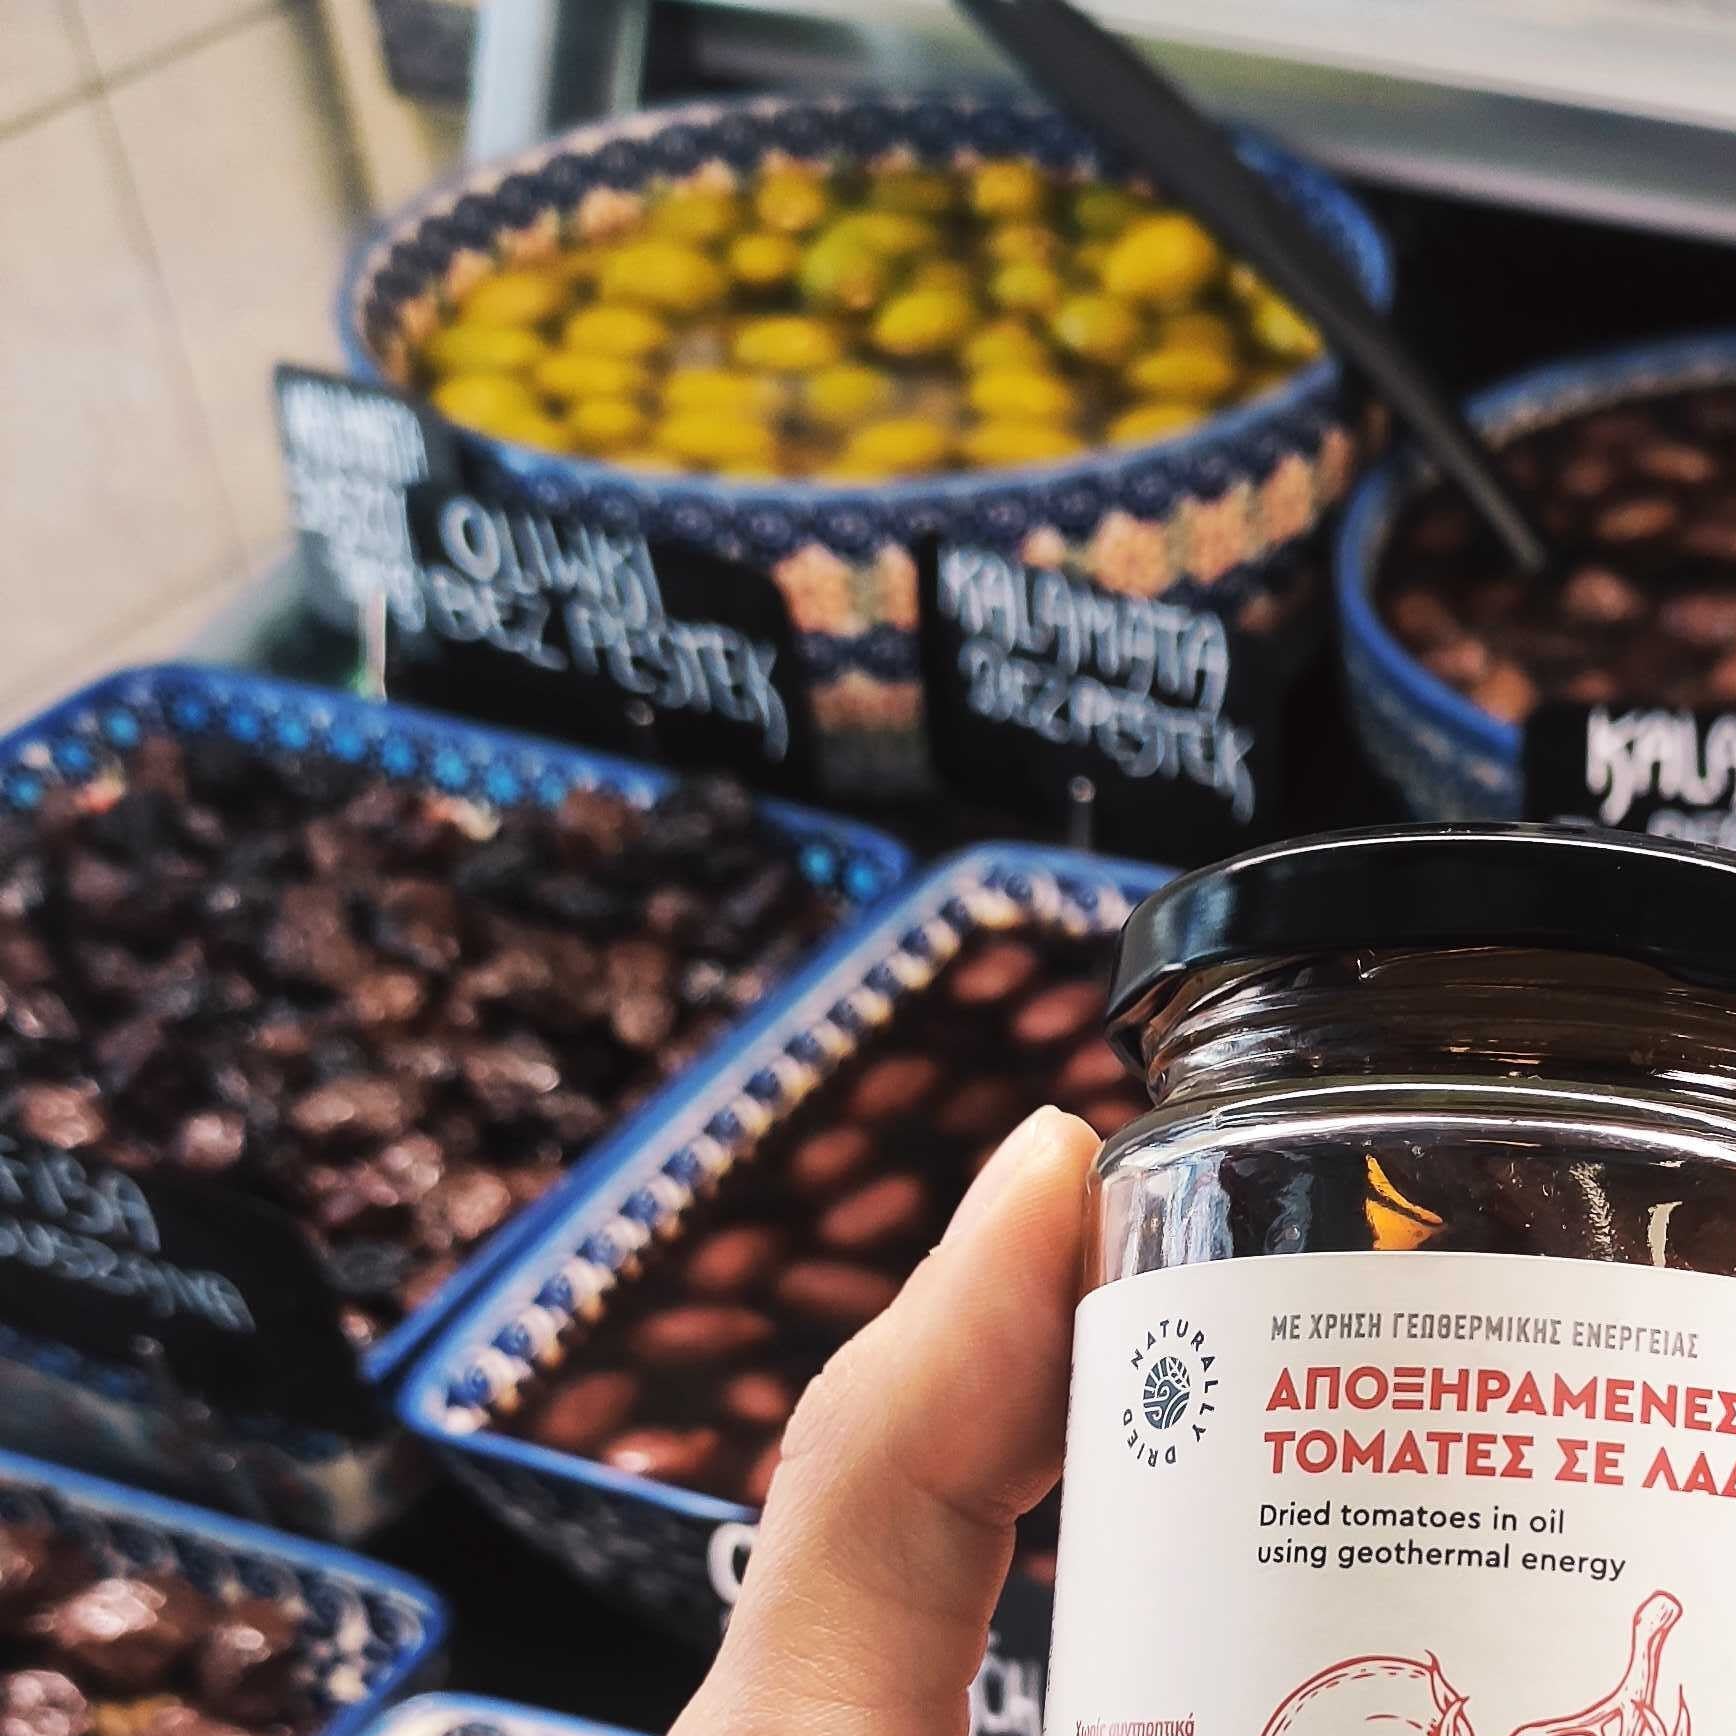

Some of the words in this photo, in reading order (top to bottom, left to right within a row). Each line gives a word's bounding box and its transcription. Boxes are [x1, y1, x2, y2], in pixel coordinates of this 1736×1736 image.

[1271, 1314, 1301, 1341] ΜΕ
[1308, 1312, 1383, 1340] ΧΡΗΣΗ
[1392, 1312, 1562, 1346] ΓΕΩΘΕΡΜΙΚΗΣ
[1572, 1320, 1699, 1359] ΕΝΕΡΓΕΙΑΣ
[1131, 1319, 1219, 1442] NATURALLY
[1122, 1408, 1176, 1467] DRIED
[1264, 1429, 1534, 1479] ΤΟΜΑΤΕΣ
[1555, 1438, 1625, 1486] ΣΕ
[1260, 1500, 1331, 1527] Dried
[1340, 1504, 1481, 1530] tomatoes
[1493, 1505, 1517, 1531] in
[1529, 1508, 1564, 1534] oil
[1258, 1538, 1327, 1569] using
[1338, 1538, 1510, 1569] geothermal
[1521, 1551, 1626, 1582] energy
